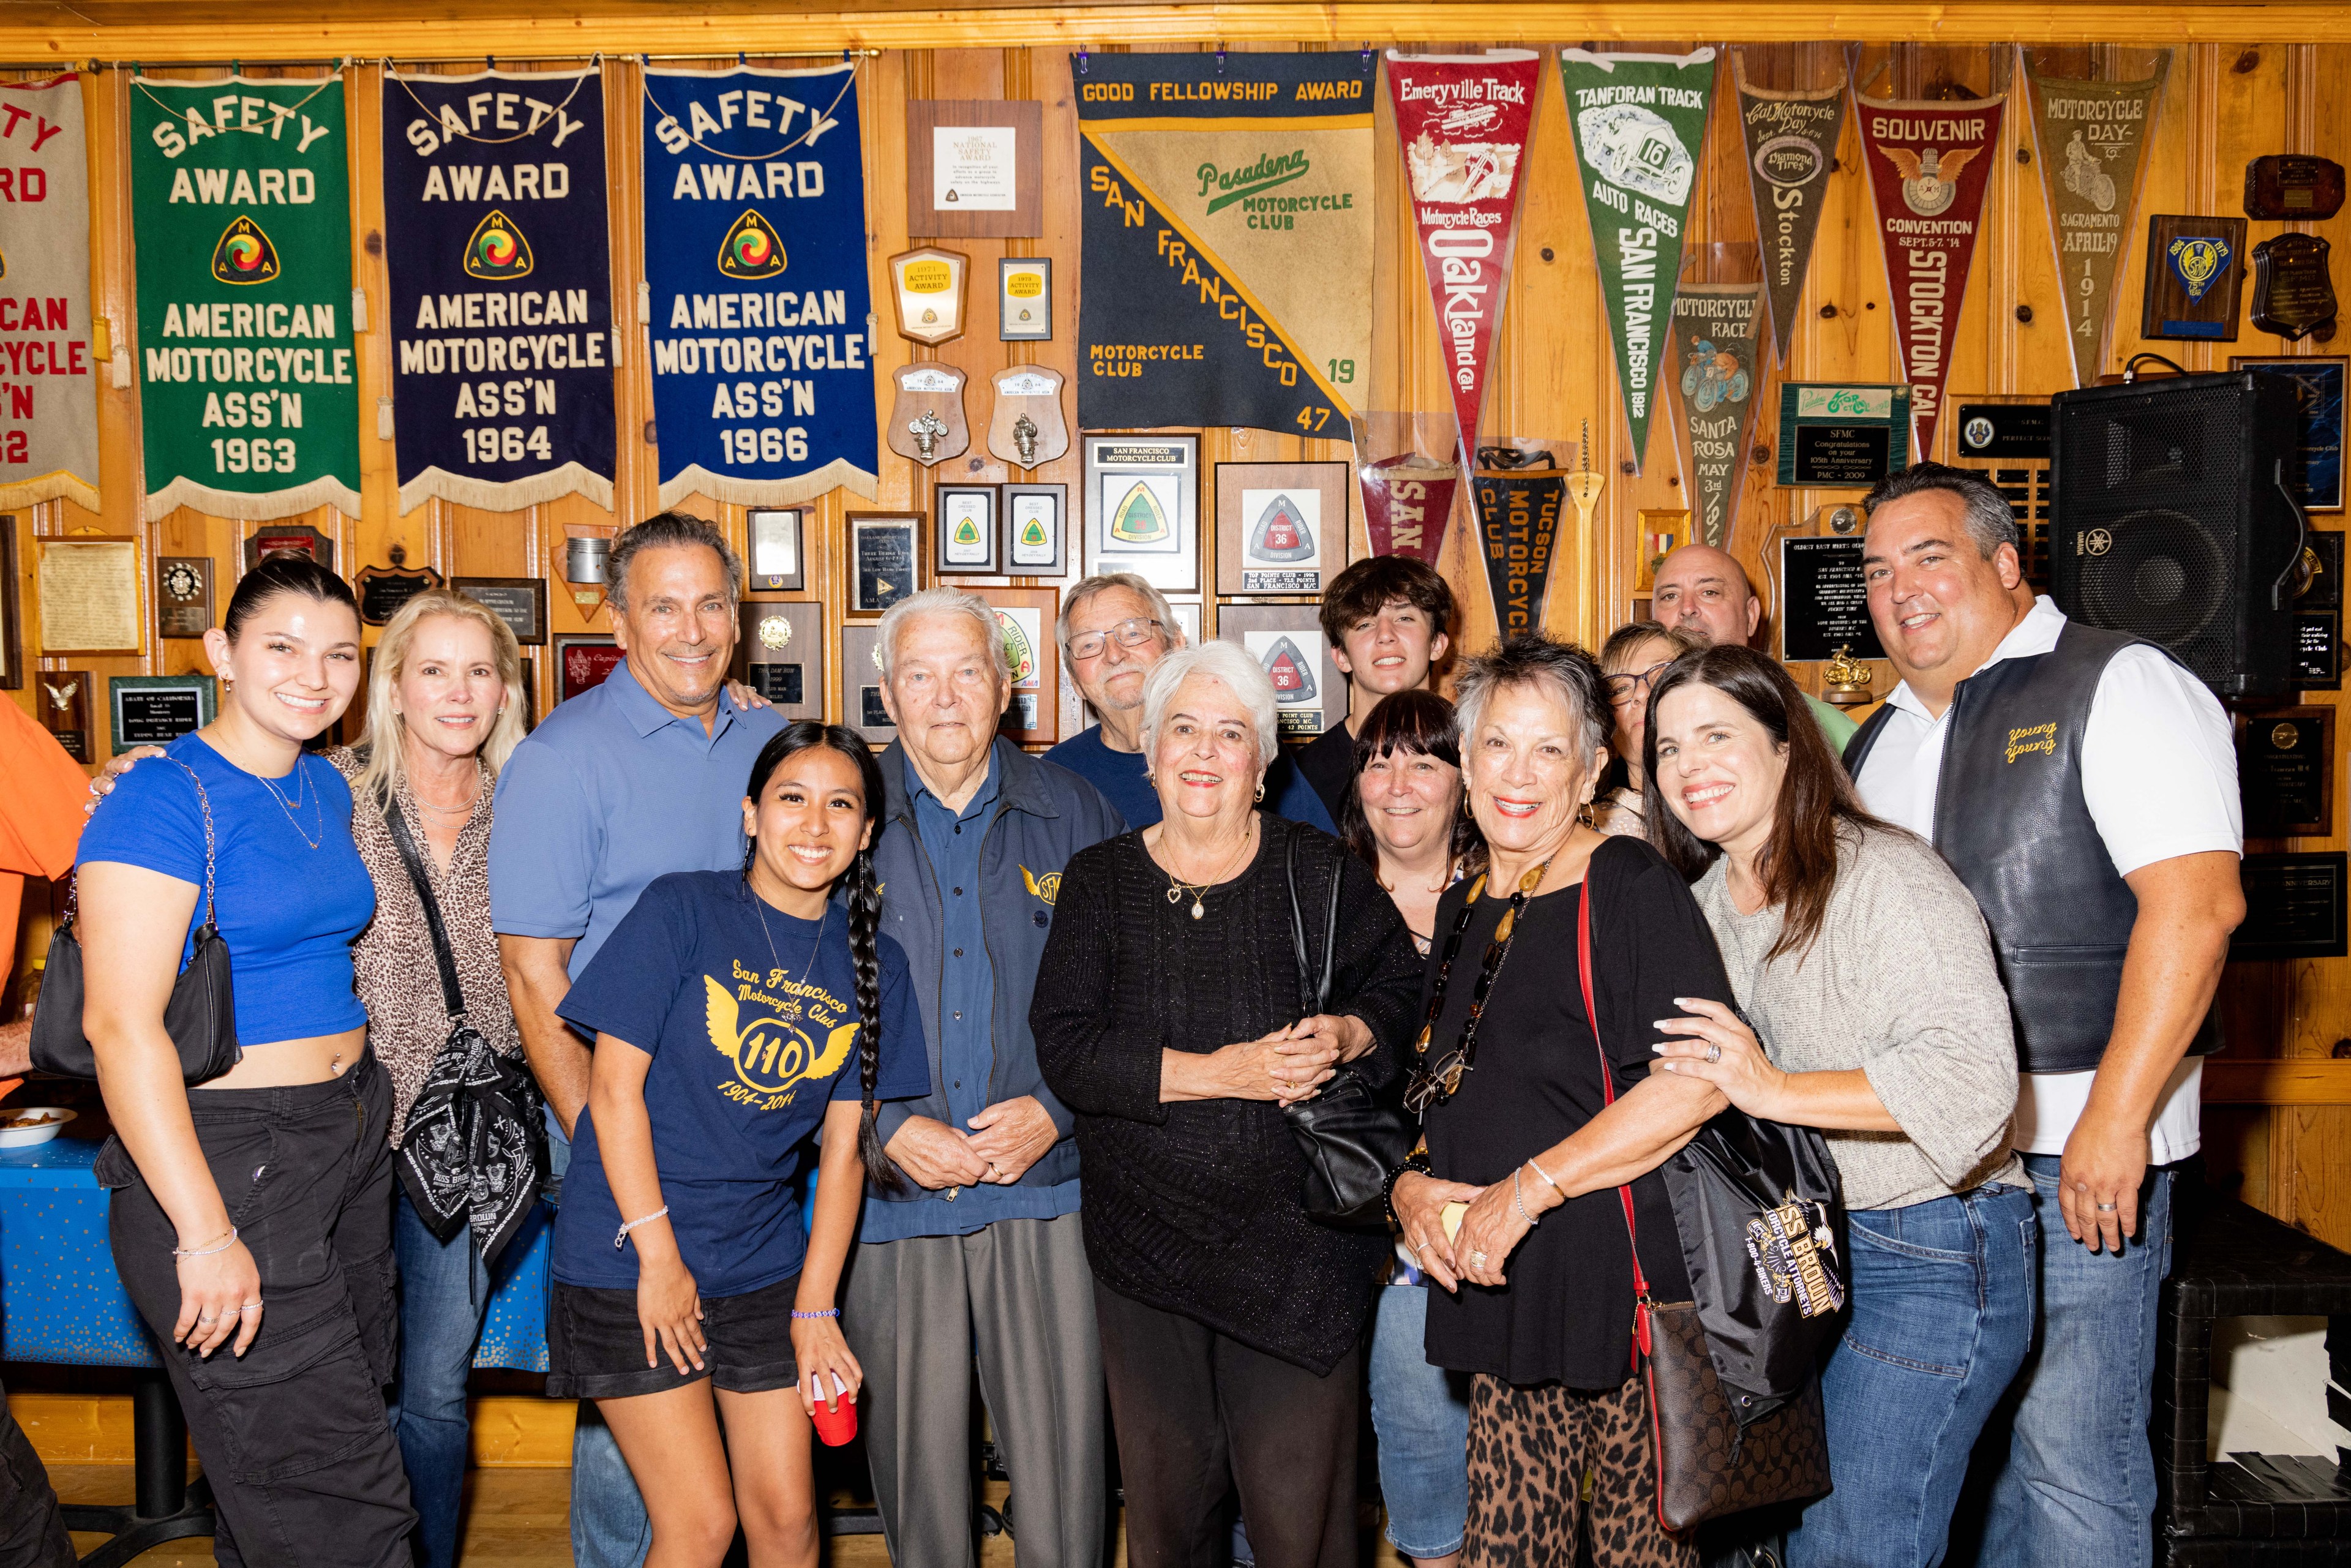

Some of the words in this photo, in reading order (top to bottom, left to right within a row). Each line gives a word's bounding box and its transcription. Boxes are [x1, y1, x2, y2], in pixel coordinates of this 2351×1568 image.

[1082, 83, 1134, 102] GOOD
[1150, 82, 1278, 100] FELLOWSHIP
[1295, 80, 1362, 101] AWARD
[1400, 78, 1483, 103] Emeryville
[1482, 78, 1524, 104] Track
[1576, 86, 1654, 108] TANFORAN
[1657, 88, 1703, 110] TRACK
[407, 92, 584, 157] SAFETY
[655, 90, 839, 154] SAFETY
[1745, 102, 1772, 125] Cal.
[1767, 102, 1835, 122] Motorcycle
[2047, 98, 2142, 121] MOTORCYCLE
[153, 95, 329, 159] SAFETY
[1779, 116, 1806, 134] Day
[1873, 118, 1984, 141] SOUVENIR
[1643, 138, 1664, 161] 16
[1768, 152, 1812, 166] Diamond
[673, 162, 824, 200] AWARD
[1197, 149, 1310, 202] Pasadena
[1777, 161, 1804, 171] Tires
[169, 169, 315, 204] AWARD
[422, 163, 569, 201] AWARD
[1243, 194, 1352, 212] MOTORCYCLE
[1422, 207, 1470, 228] Motorcycle
[1469, 208, 1502, 227] Races
[1592, 181, 1628, 214] AUTO
[1635, 199, 1678, 238] RACES
[1247, 215, 1294, 230] CLUB
[1773, 185, 1803, 286] Stockton
[1886, 218, 1972, 234] CONVENTION
[2061, 214, 2119, 228] SACRAMENTO
[1619, 227, 1657, 281] SAN
[2169, 239, 2185, 256] 1904
[2214, 241, 2229, 257] 1979
[1090, 165, 1145, 227] SAN
[1158, 230, 1297, 386] FRANCISCO
[416, 290, 588, 329] AMERICAN
[670, 291, 846, 329] AMERICAN
[1428, 229, 1493, 367] Oakland
[2076, 258, 2093, 337] 1914
[162, 304, 336, 338] AMERICAN
[1908, 251, 1947, 377] STOCKTON
[1624, 283, 1654, 390] FRANCISCO
[1711, 322, 1747, 337] RACE
[146, 348, 352, 384] MOTORCYCLE
[400, 333, 606, 375] MOTORCYCLE
[654, 334, 865, 375] MOTORCYCLE
[1090, 345, 1204, 360] MOTORCYCLE
[1093, 361, 1142, 377] CLUB
[1328, 359, 1354, 383] 19
[202, 391, 302, 428] ASS'N
[455, 377, 557, 419] ASS'N
[712, 380, 815, 420] ASS'N
[1632, 392, 1645, 418] 1912
[1297, 407, 1330, 432] 47
[1690, 416, 1738, 439] SANTA
[1830, 430, 1854, 438] SFMC
[211, 438, 296, 473] 1963
[462, 426, 552, 464] 1964
[721, 427, 808, 465] 1966
[1693, 441, 1735, 459] ROSA
[1815, 440, 1870, 449] Congratulations
[1698, 463, 1730, 476] MAY
[1831, 457, 1873, 465] Anniversary
[1704, 479, 1722, 492] 3rd
[1119, 505, 1128, 519] ROAD
[1153, 505, 1162, 520] RIDER
[1295, 519, 1305, 535] RIDER
[1390, 480, 1426, 549] SAN
[1481, 489, 1505, 560] CLUB
[1257, 520, 1267, 535] ROAD
[1275, 534, 1287, 544] 36
[1530, 489, 1559, 573] TUCSON
[1008, 626, 1027, 656] RIDER
[1277, 675, 1289, 686] 36
[1297, 661, 1308, 677] RIDER
[733, 959, 759, 984] San
[766, 968, 847, 1013] Francisco
[738, 984, 802, 1014] Motorcycle
[808, 1003, 838, 1029] Club
[744, 1032, 802, 1078] 110
[718, 1080, 797, 1111] 1904-2014
[1745, 1237, 1773, 1295] 1-800-4-BIKERS
[1790, 1236, 1833, 1317] BROWN
[1786, 1259, 1813, 1315] ATTORNEYS
